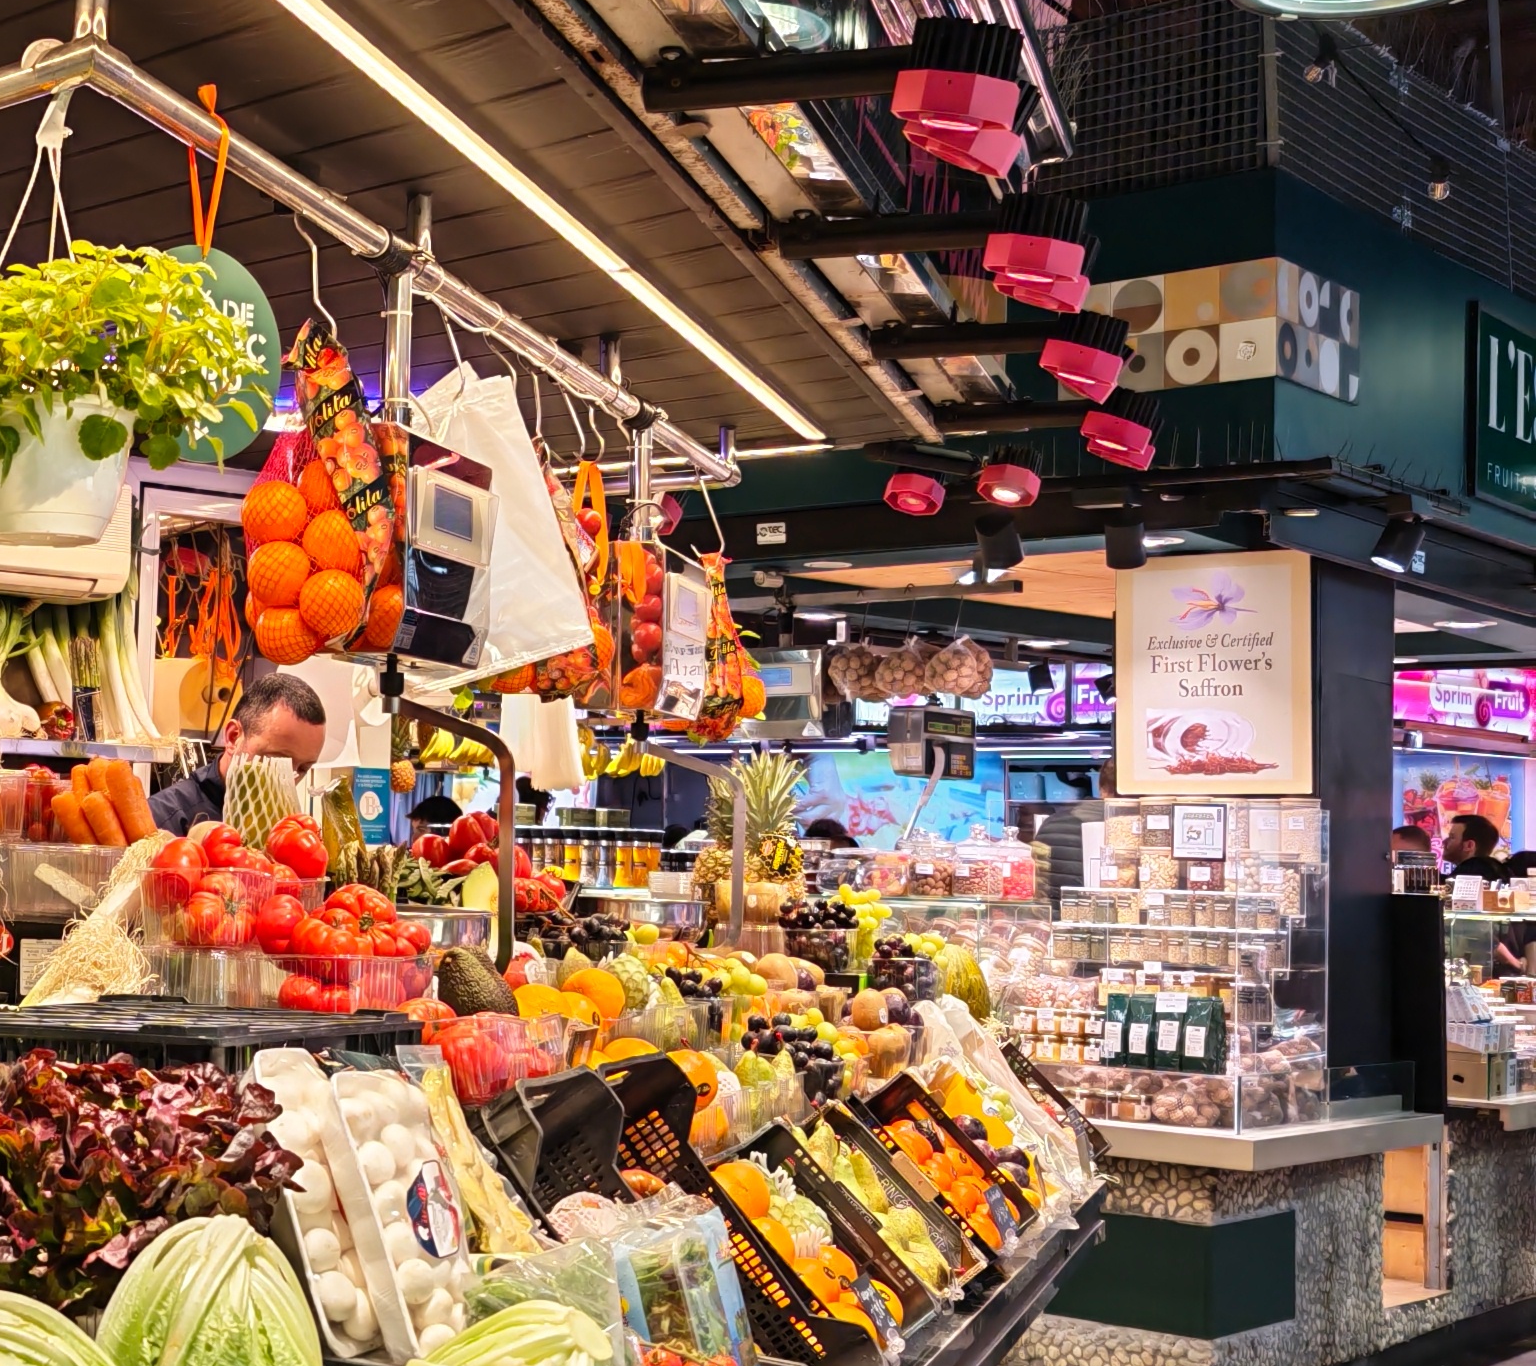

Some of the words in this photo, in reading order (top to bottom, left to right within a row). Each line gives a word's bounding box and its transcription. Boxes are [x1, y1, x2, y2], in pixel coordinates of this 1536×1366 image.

[1488, 335, 1536, 444] L'E
[1146, 635, 1202, 651] Exclusive
[1205, 633, 1218, 648] &
[1221, 631, 1275, 652] Certified
[1150, 655, 1193, 674] First
[1197, 651, 1273, 673] Flower's
[1178, 677, 1244, 698] Saffron
[1434, 684, 1473, 709] Sprim
[1494, 688, 1525, 714] Fruit
[982, 690, 1040, 713] Sprim
